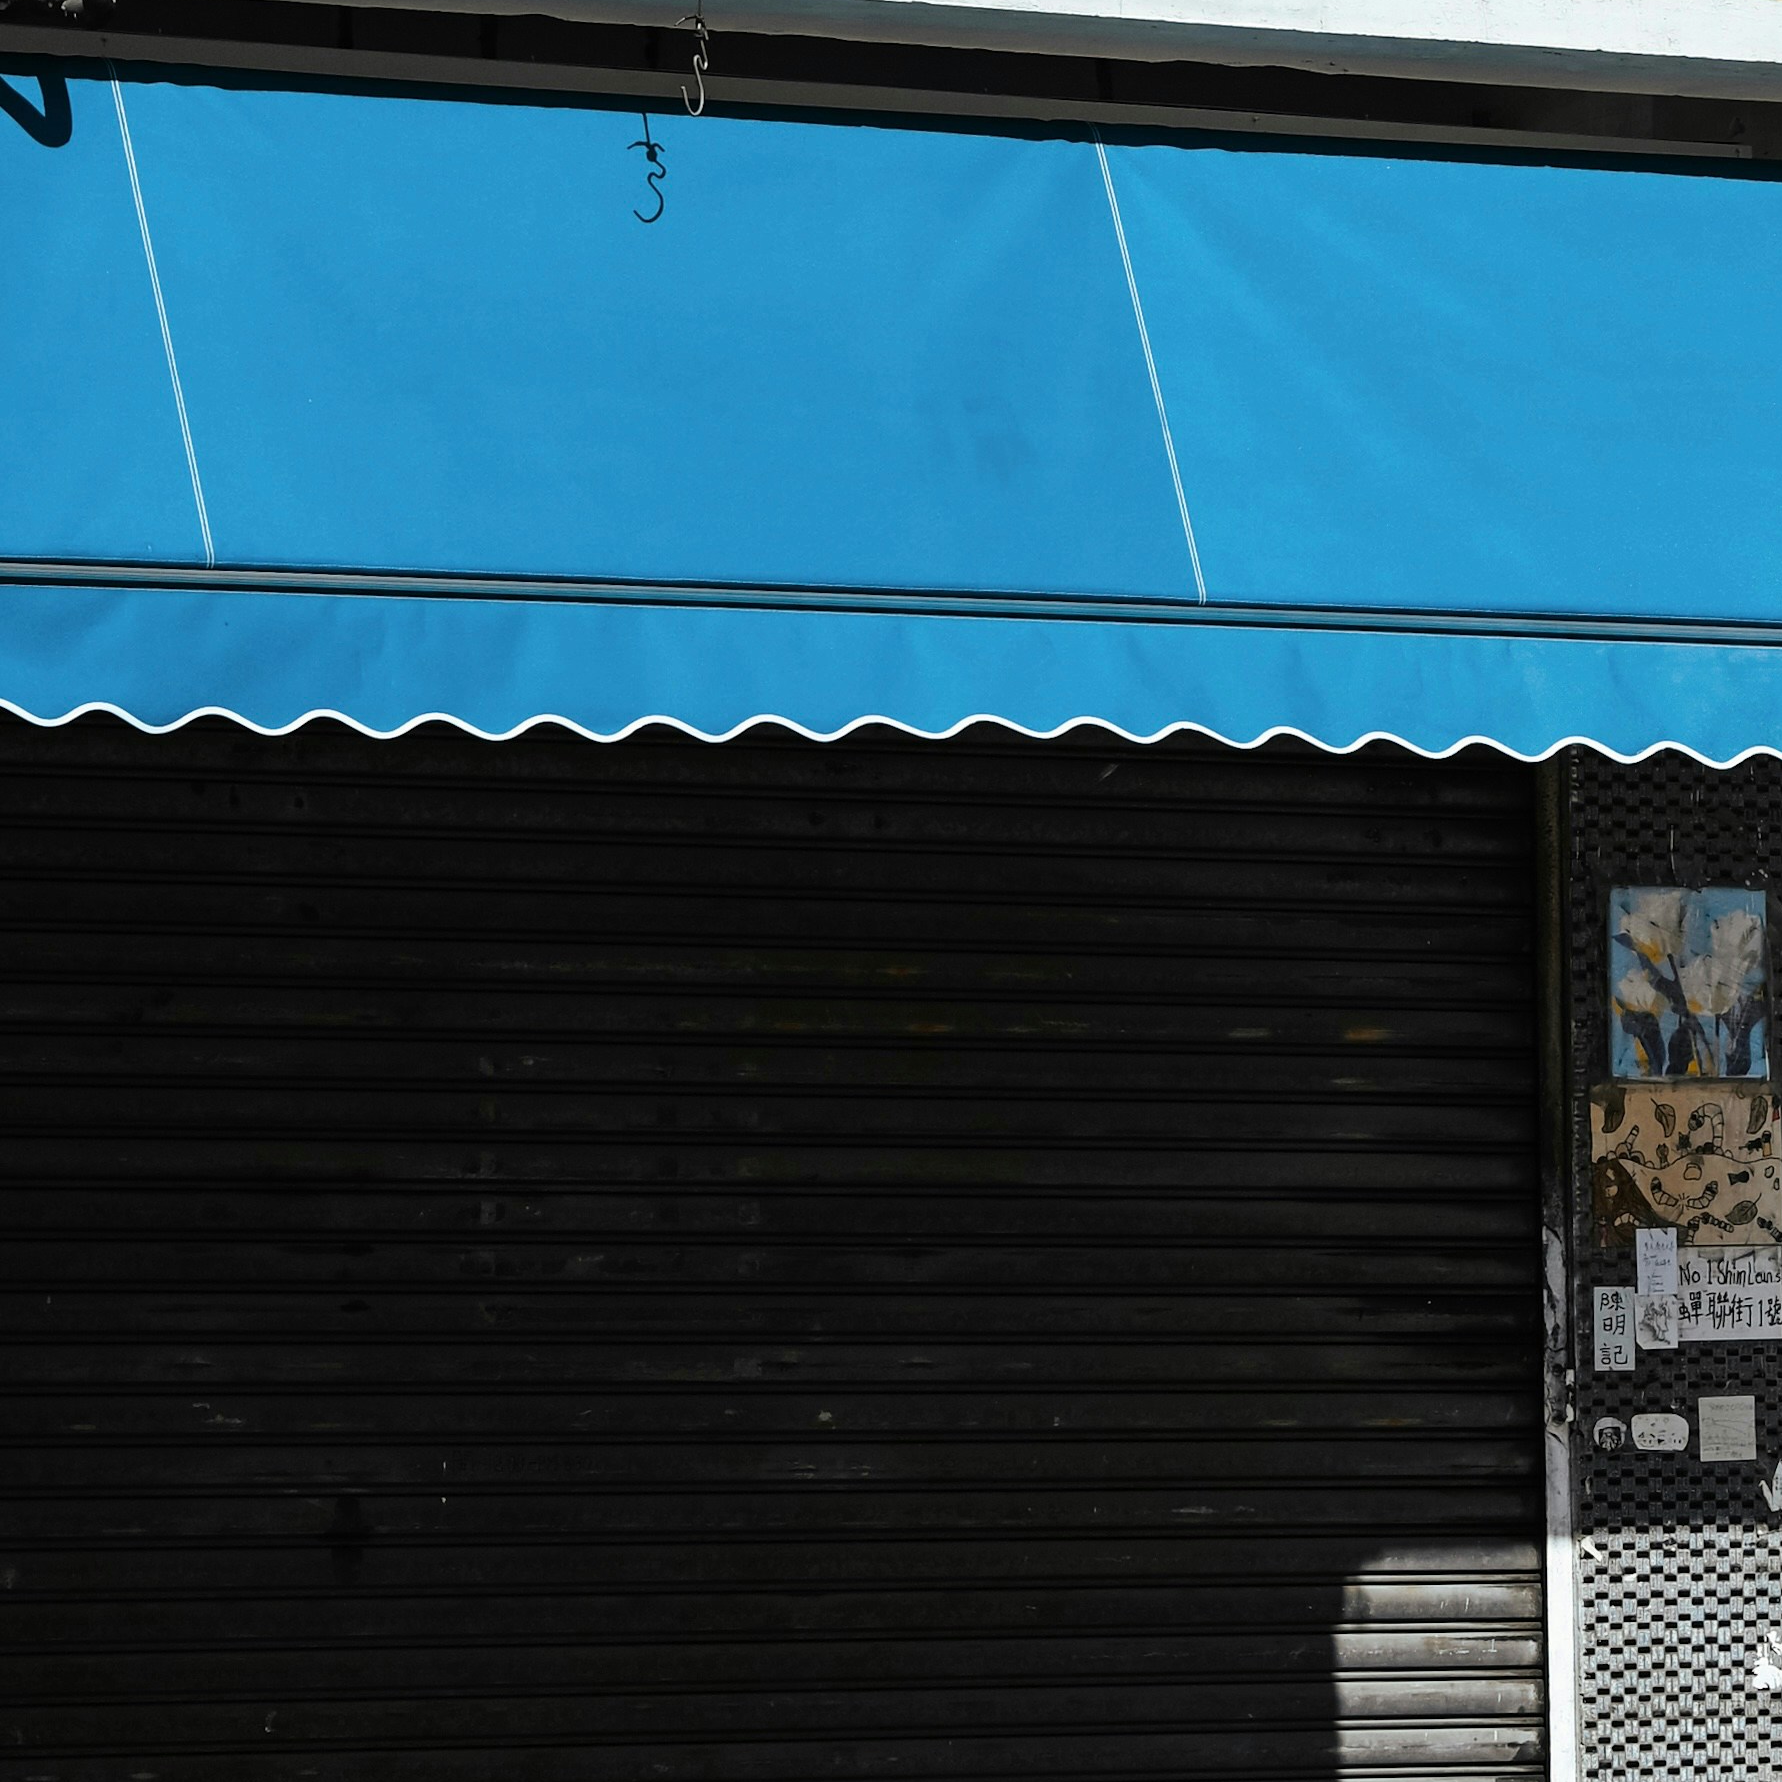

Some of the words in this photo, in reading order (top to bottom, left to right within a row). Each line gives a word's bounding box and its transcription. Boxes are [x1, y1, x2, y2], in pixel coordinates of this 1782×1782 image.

[1679, 1261, 1701, 1286] No
[1717, 1259, 1746, 1288] Shim
[1599, 1291, 1628, 1366] 陳明記
